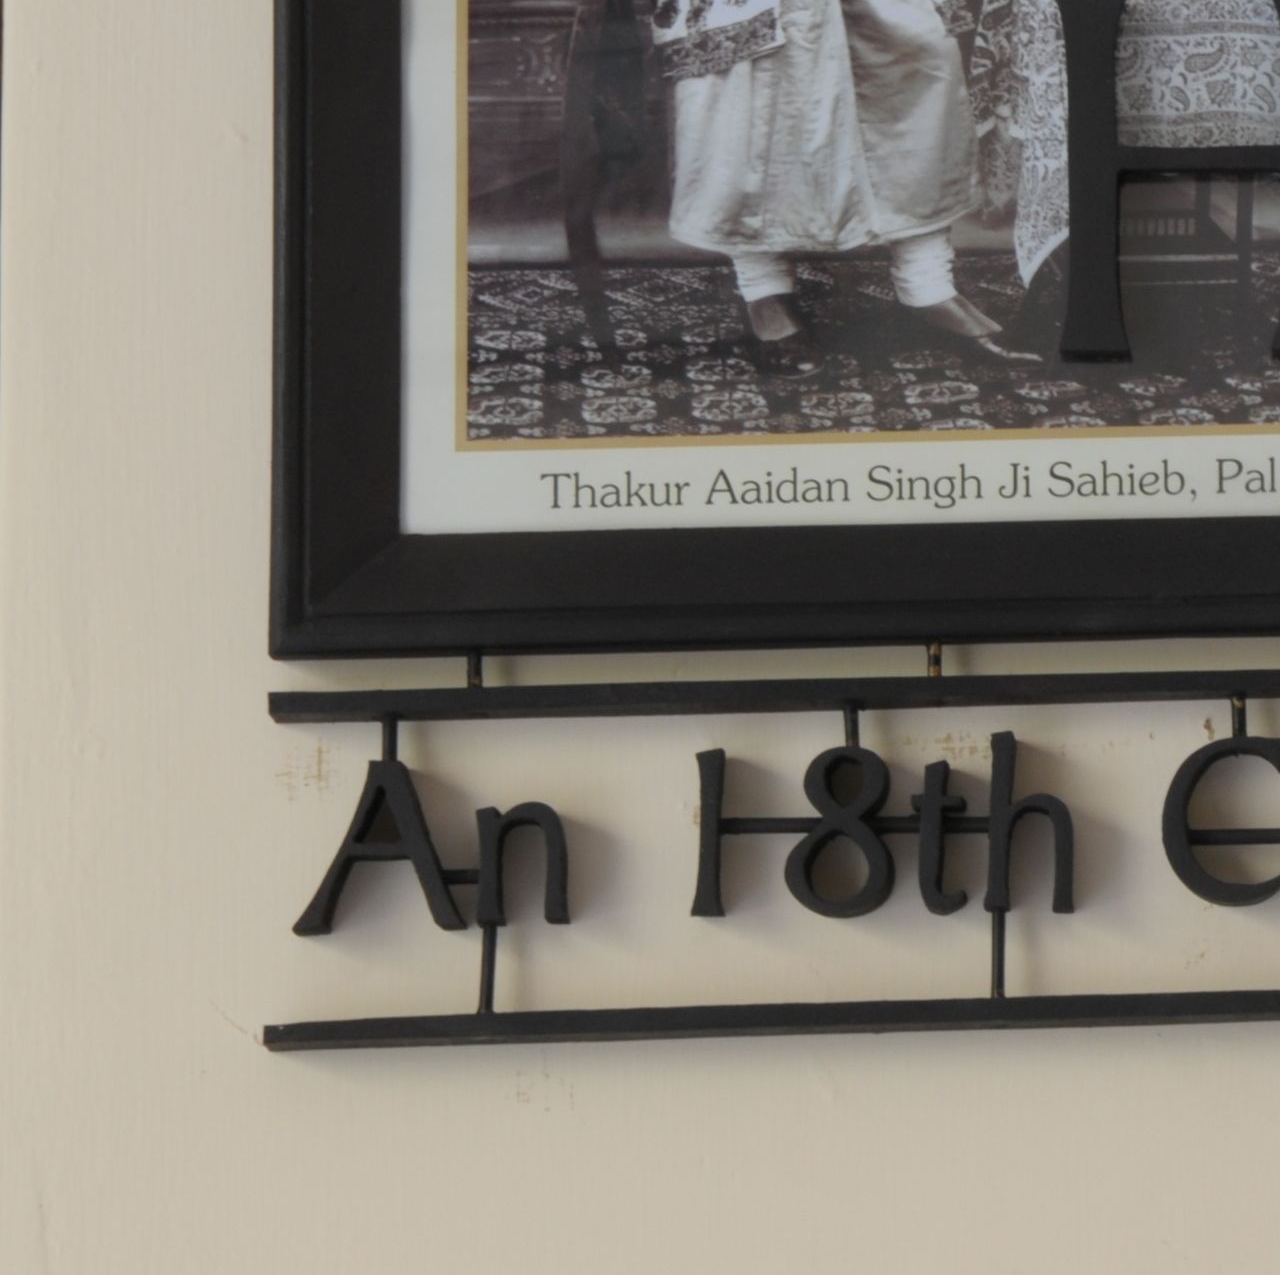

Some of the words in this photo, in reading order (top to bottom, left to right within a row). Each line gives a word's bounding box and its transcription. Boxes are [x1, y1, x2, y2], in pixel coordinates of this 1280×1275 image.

[540, 470, 691, 510] Thakur
[704, 466, 851, 506] Aaidan
[866, 463, 985, 510] Singh
[998, 462, 1033, 500] Ji
[1047, 458, 1198, 502] Sahieb,
[1215, 456, 1279, 495] Pal
[291, 758, 572, 936] An
[689, 729, 1076, 920] 18th
